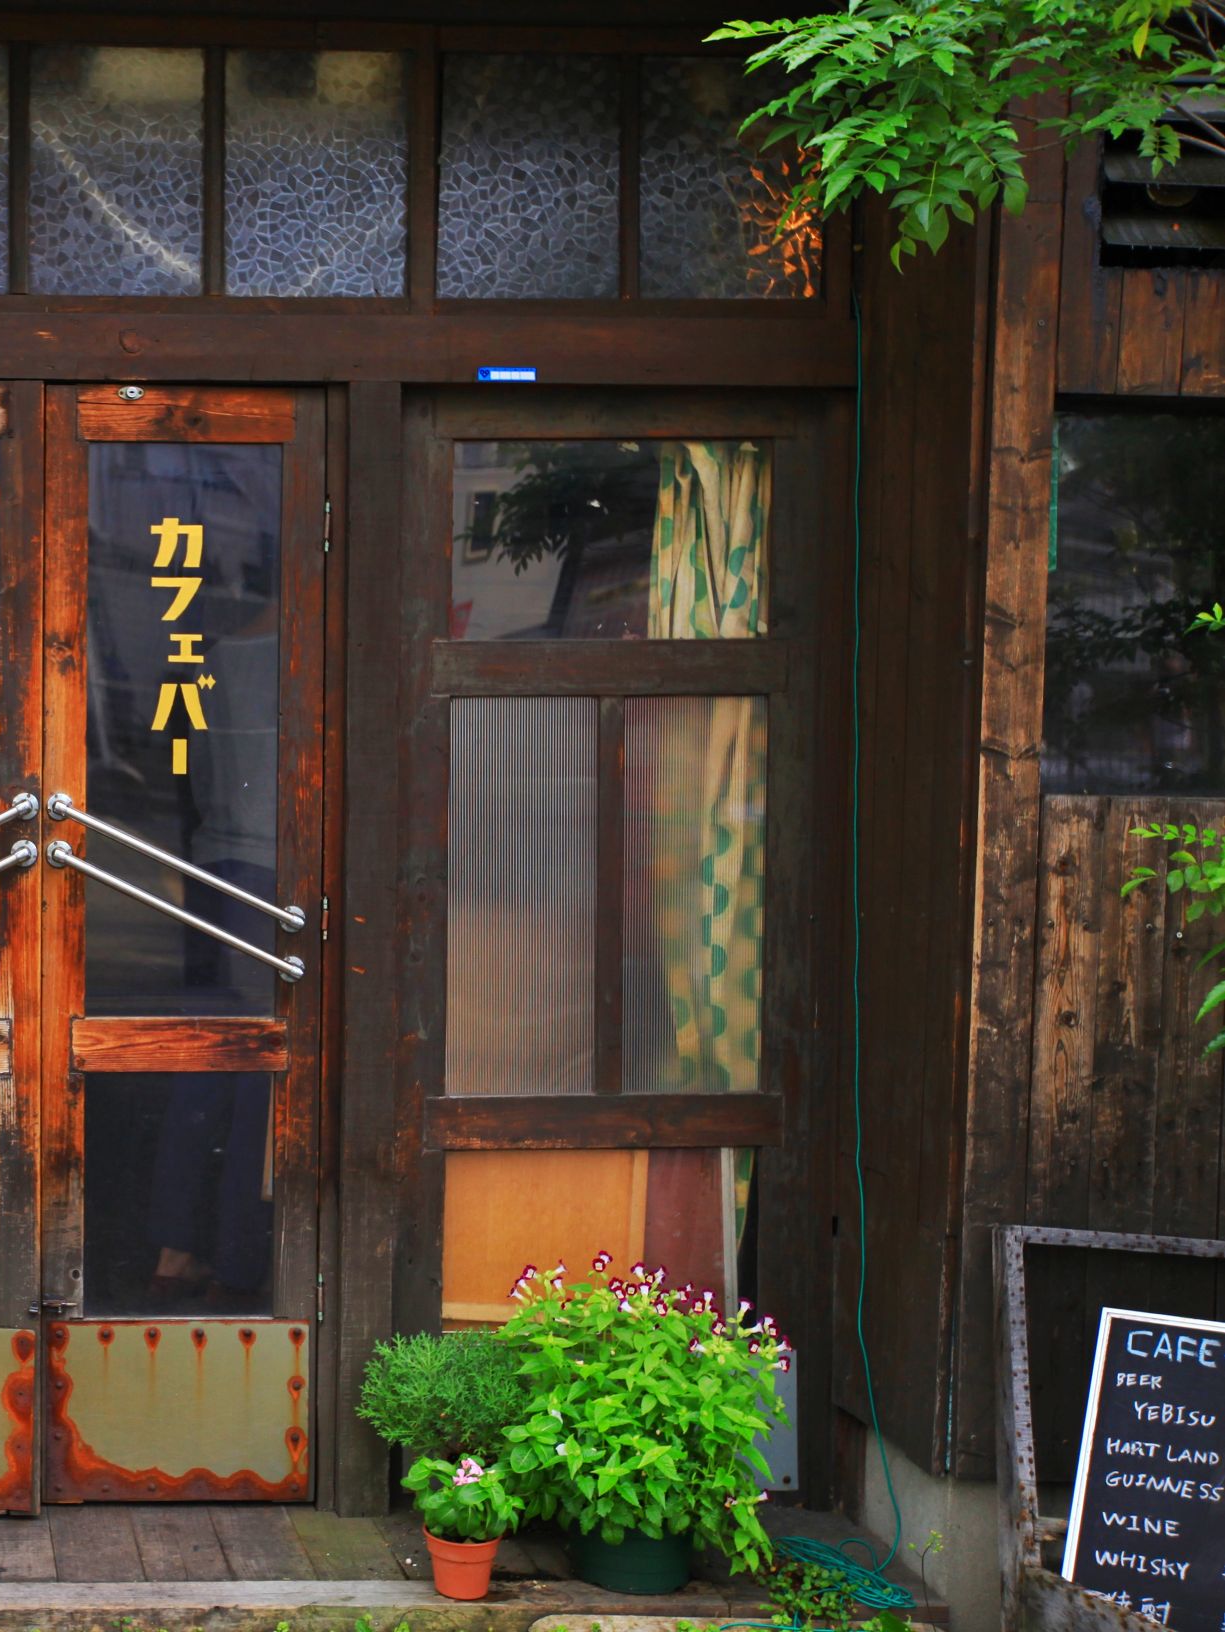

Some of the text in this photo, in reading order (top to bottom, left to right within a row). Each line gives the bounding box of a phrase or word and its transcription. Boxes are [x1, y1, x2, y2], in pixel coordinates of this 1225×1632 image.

[150, 517, 216, 775] カフェバー
[1127, 1329, 1221, 1368] CAFE
[1116, 1372, 1163, 1389] BEER
[1134, 1401, 1216, 1427] YEBISU
[1106, 1437, 1220, 1465] HART LAND
[1105, 1471, 1225, 1501] GUINNESS
[1102, 1511, 1180, 1537] WINE
[1094, 1550, 1190, 1581] WHISKY
